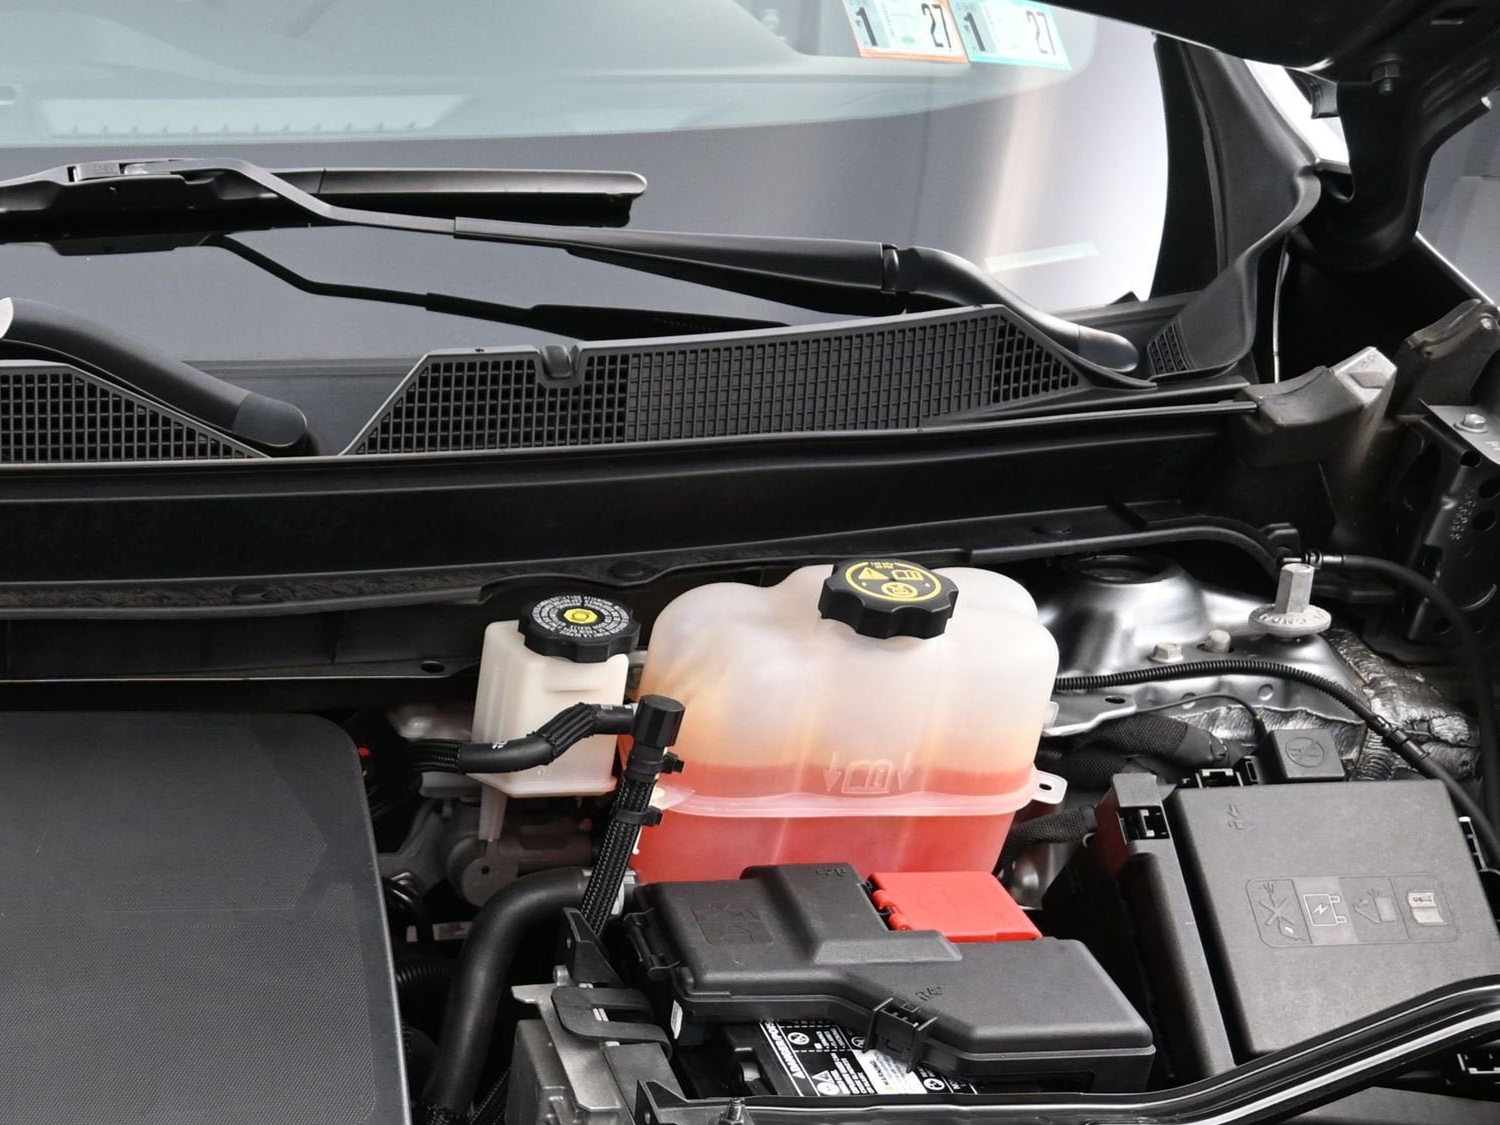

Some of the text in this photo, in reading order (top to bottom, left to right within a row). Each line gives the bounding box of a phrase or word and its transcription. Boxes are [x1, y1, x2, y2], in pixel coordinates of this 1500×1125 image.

[856, 7, 878, 47] 1
[921, 3, 952, 50] 27
[963, 12, 986, 52] 1
[1026, 10, 1056, 55] 27
